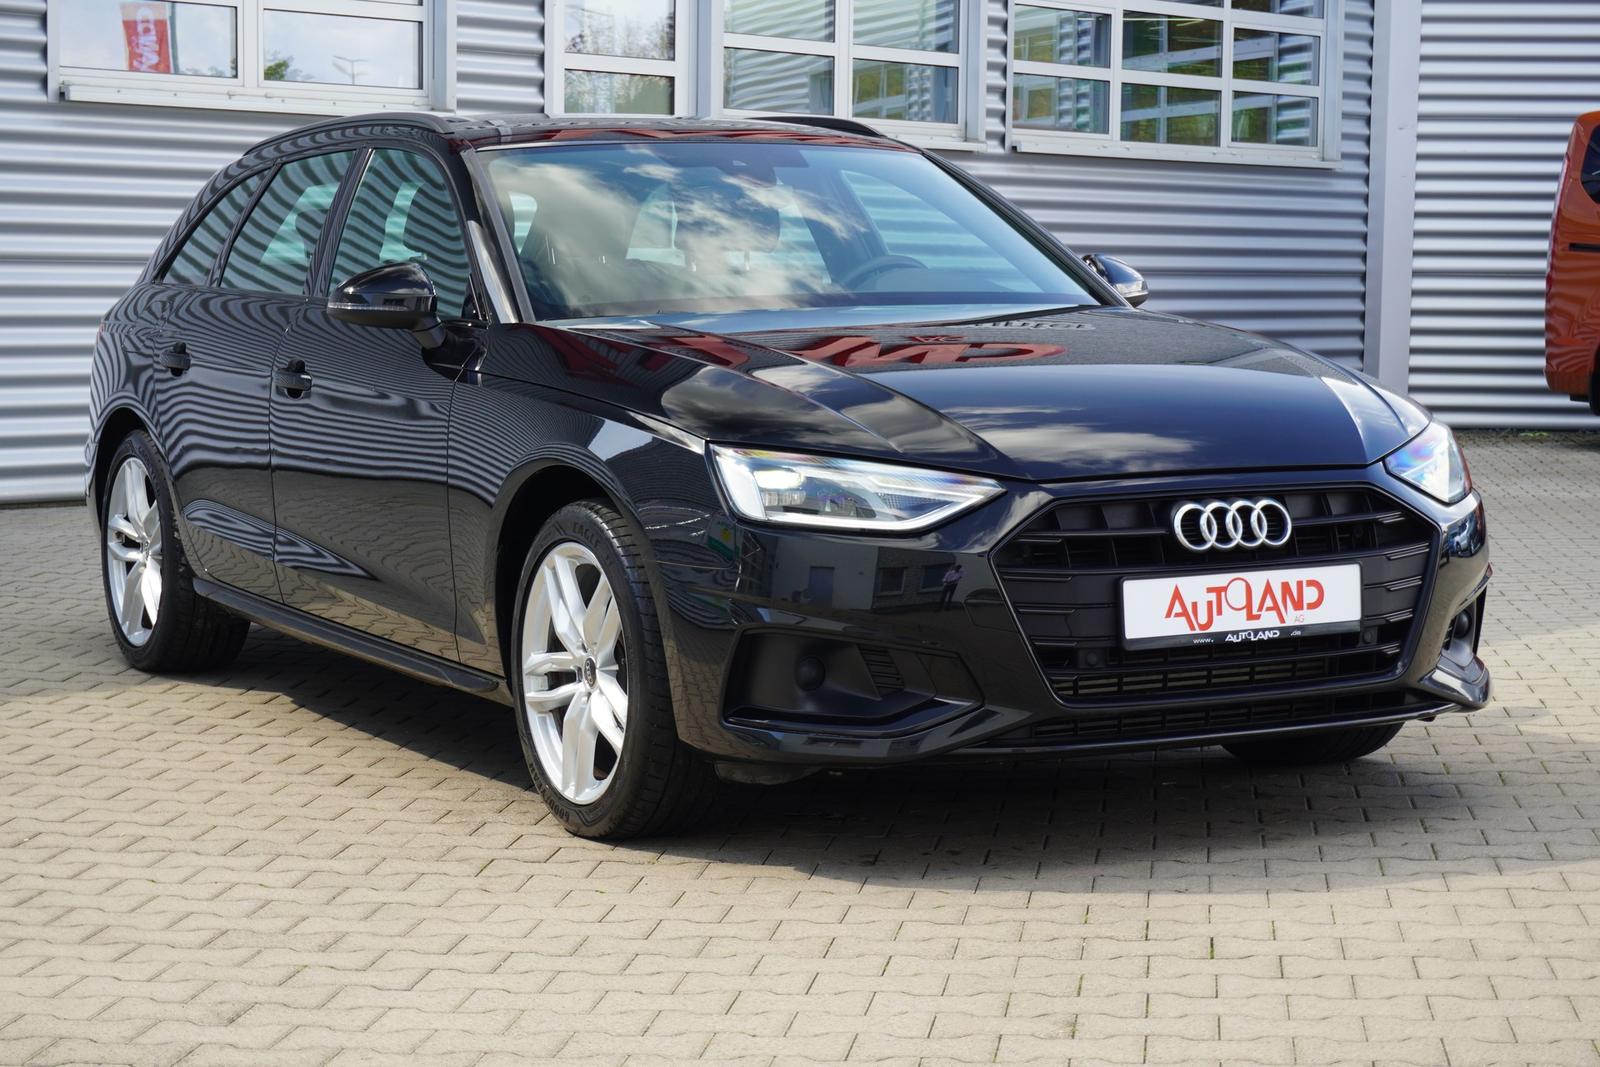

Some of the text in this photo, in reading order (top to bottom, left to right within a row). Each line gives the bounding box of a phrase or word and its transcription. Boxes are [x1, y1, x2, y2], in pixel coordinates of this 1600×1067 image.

[1165, 577, 1325, 632] AUTOLAND
[1294, 614, 1305, 624] AG
[1225, 630, 1281, 643] AUTOLAND
